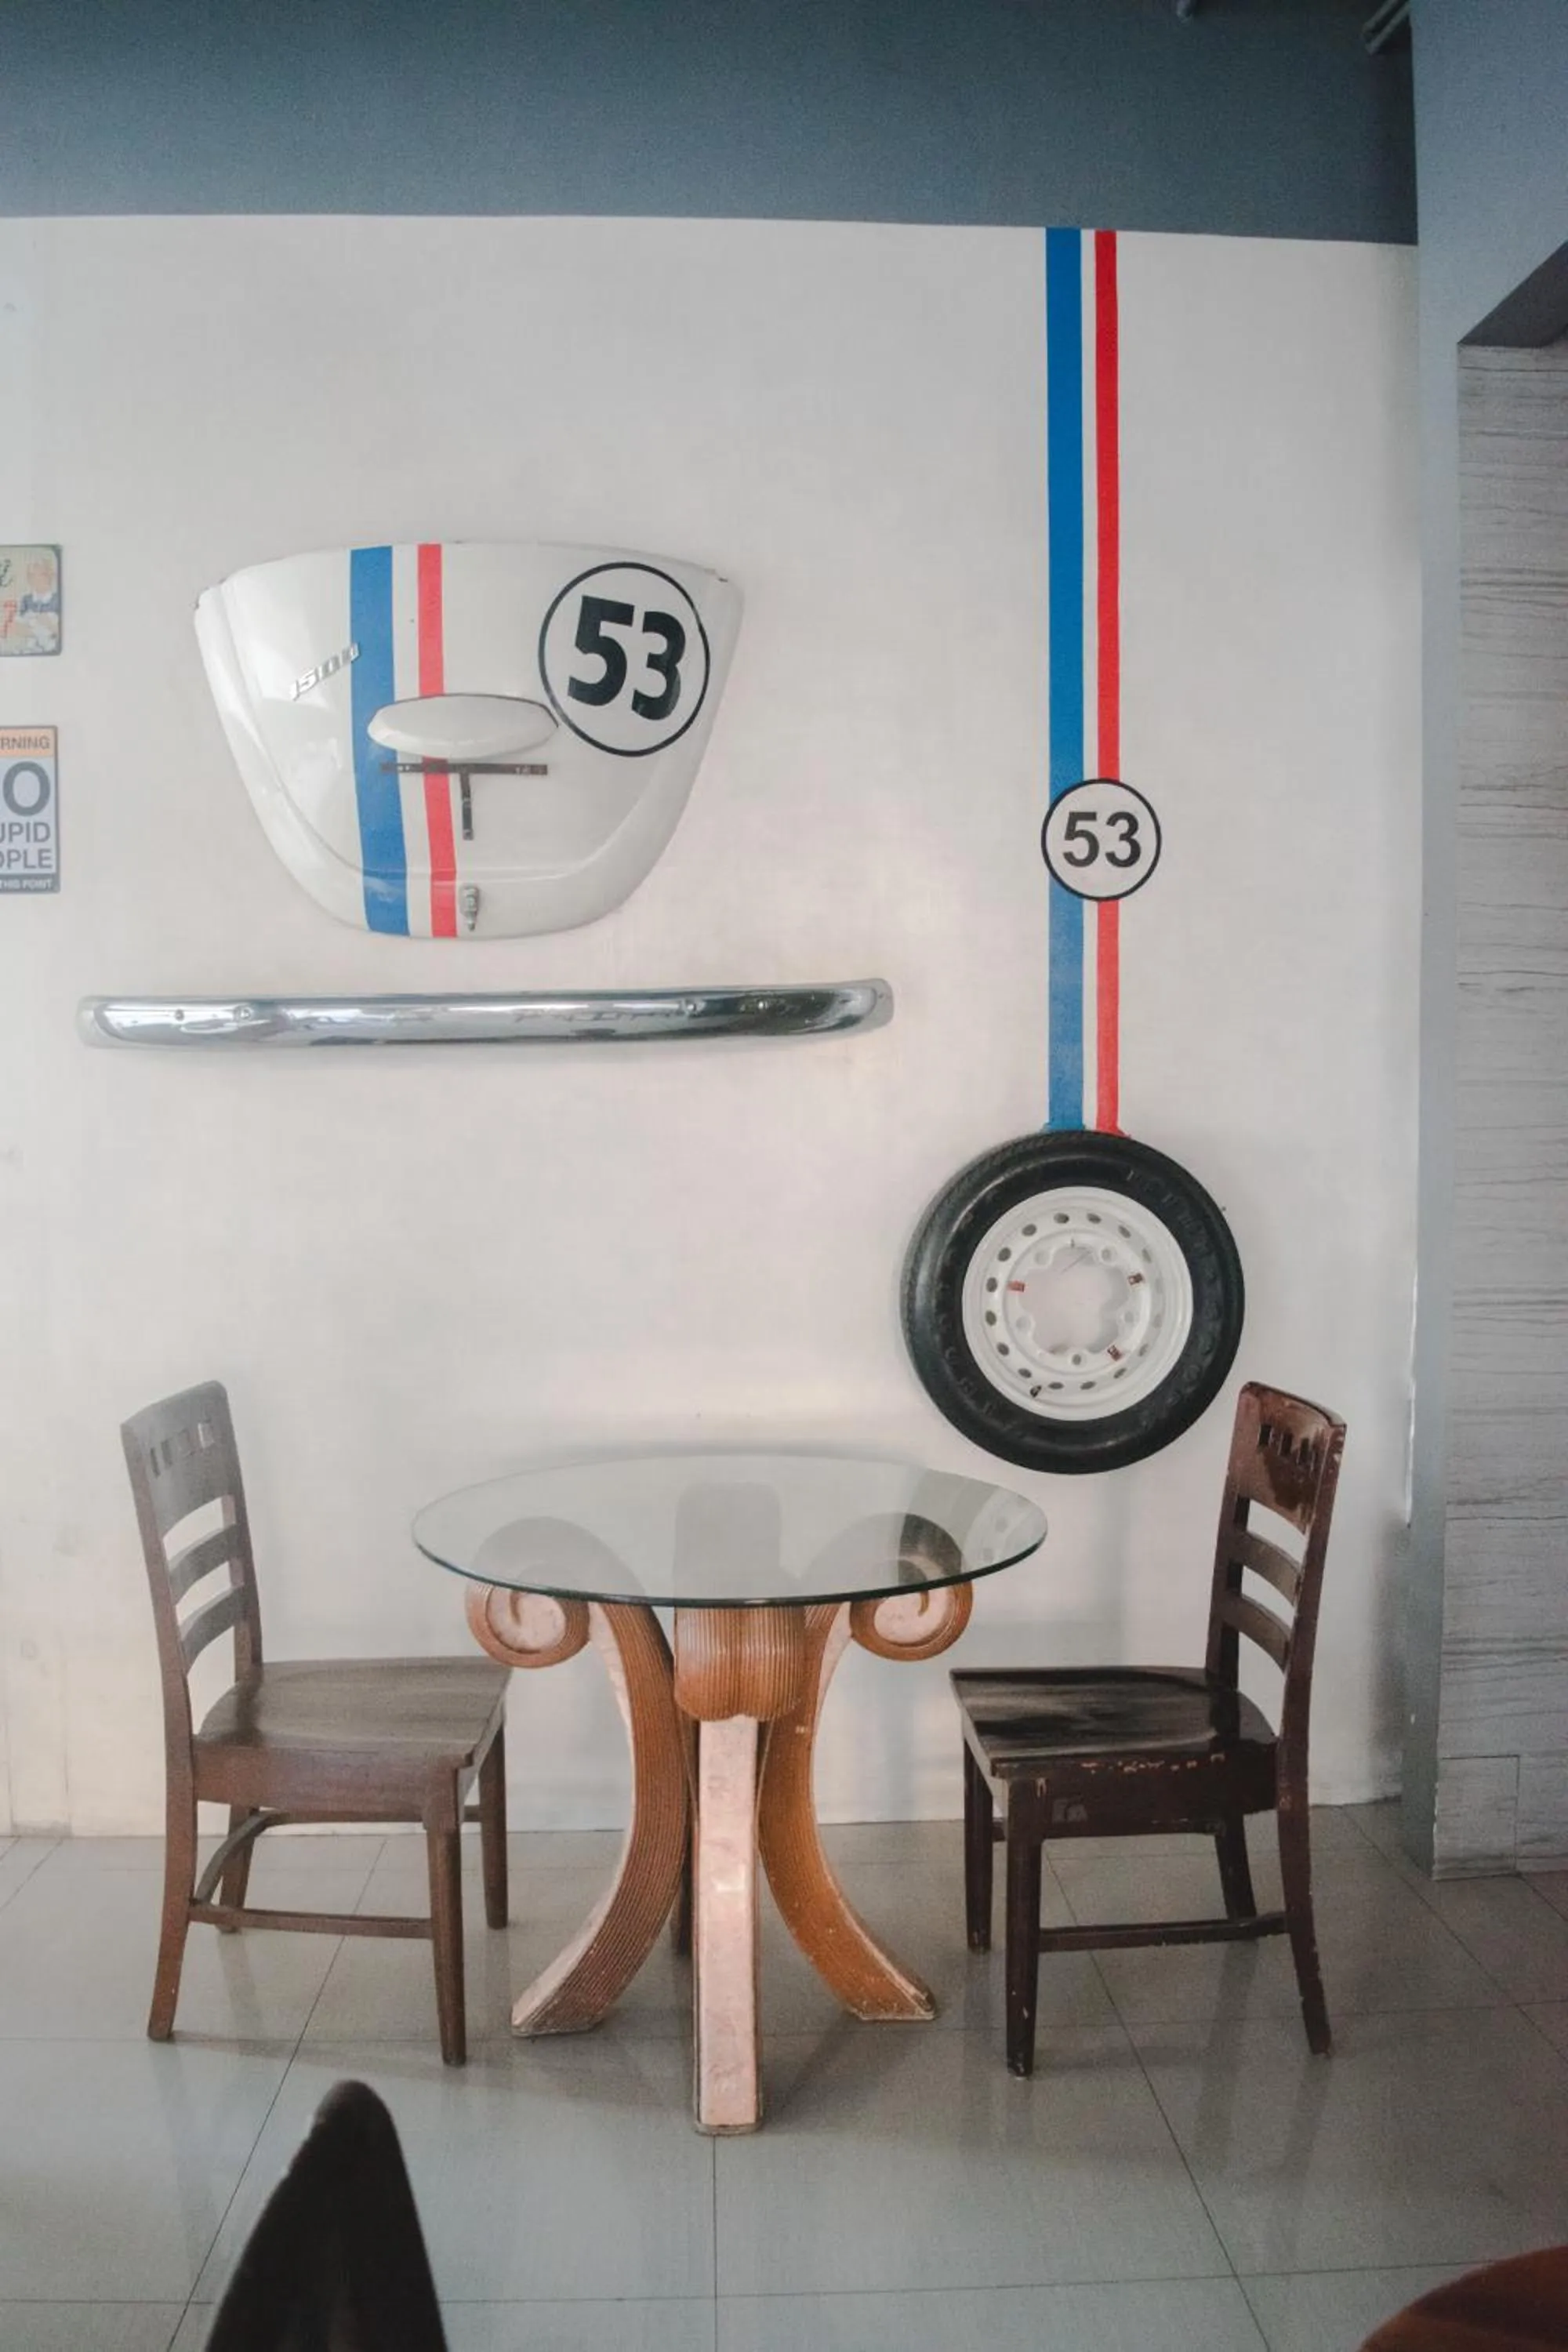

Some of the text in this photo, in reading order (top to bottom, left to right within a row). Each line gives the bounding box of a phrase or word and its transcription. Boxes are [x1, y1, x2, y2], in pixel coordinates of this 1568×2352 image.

[567, 595, 685, 720] 53
[2, 760, 50, 816] O
[0, 848, 53, 869] PLE
[1062, 811, 1142, 868] 53
